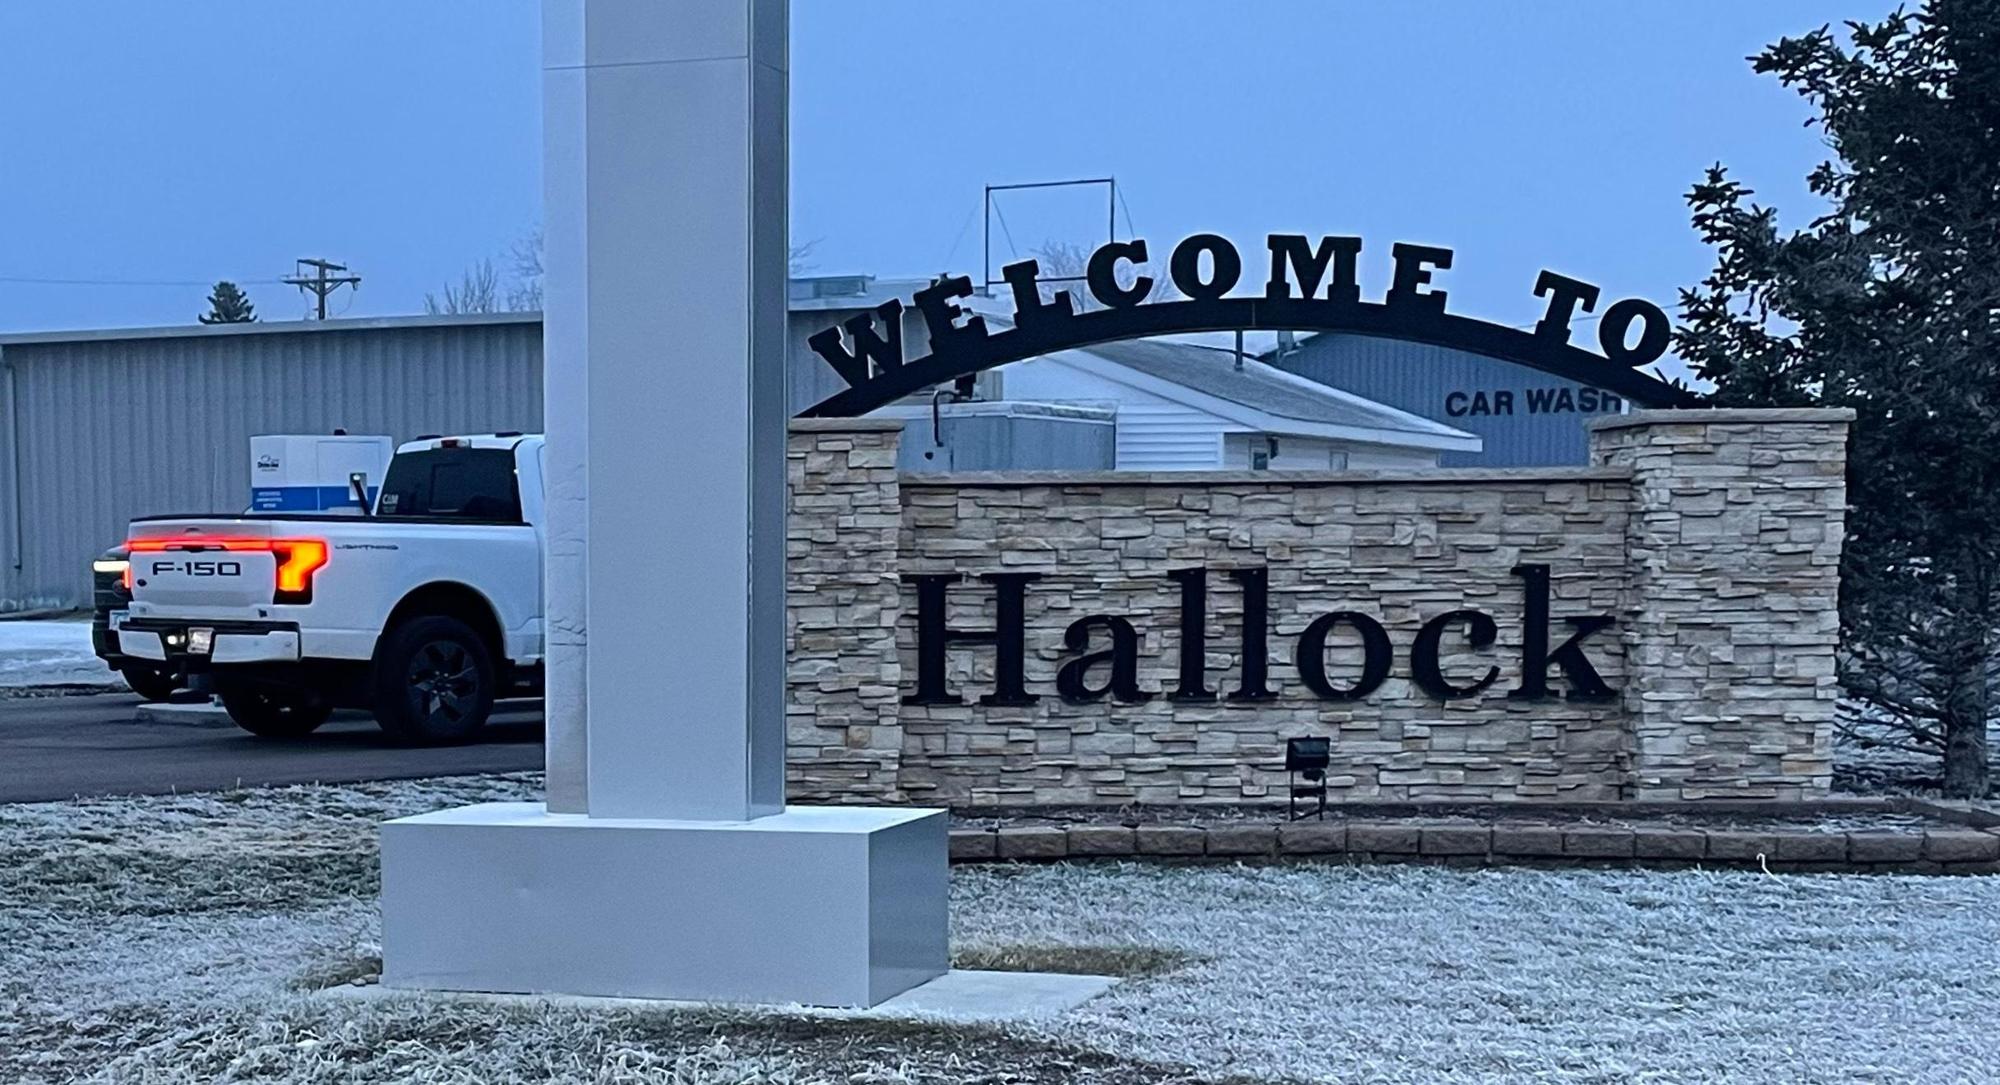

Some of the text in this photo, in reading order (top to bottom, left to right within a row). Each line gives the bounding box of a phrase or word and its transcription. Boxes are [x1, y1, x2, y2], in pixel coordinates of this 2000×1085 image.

[808, 231, 1671, 386] WELCOME TO
[1445, 387, 1622, 417] CAR WASH
[152, 561, 241, 576] F-150
[901, 564, 1618, 705] Hallock
